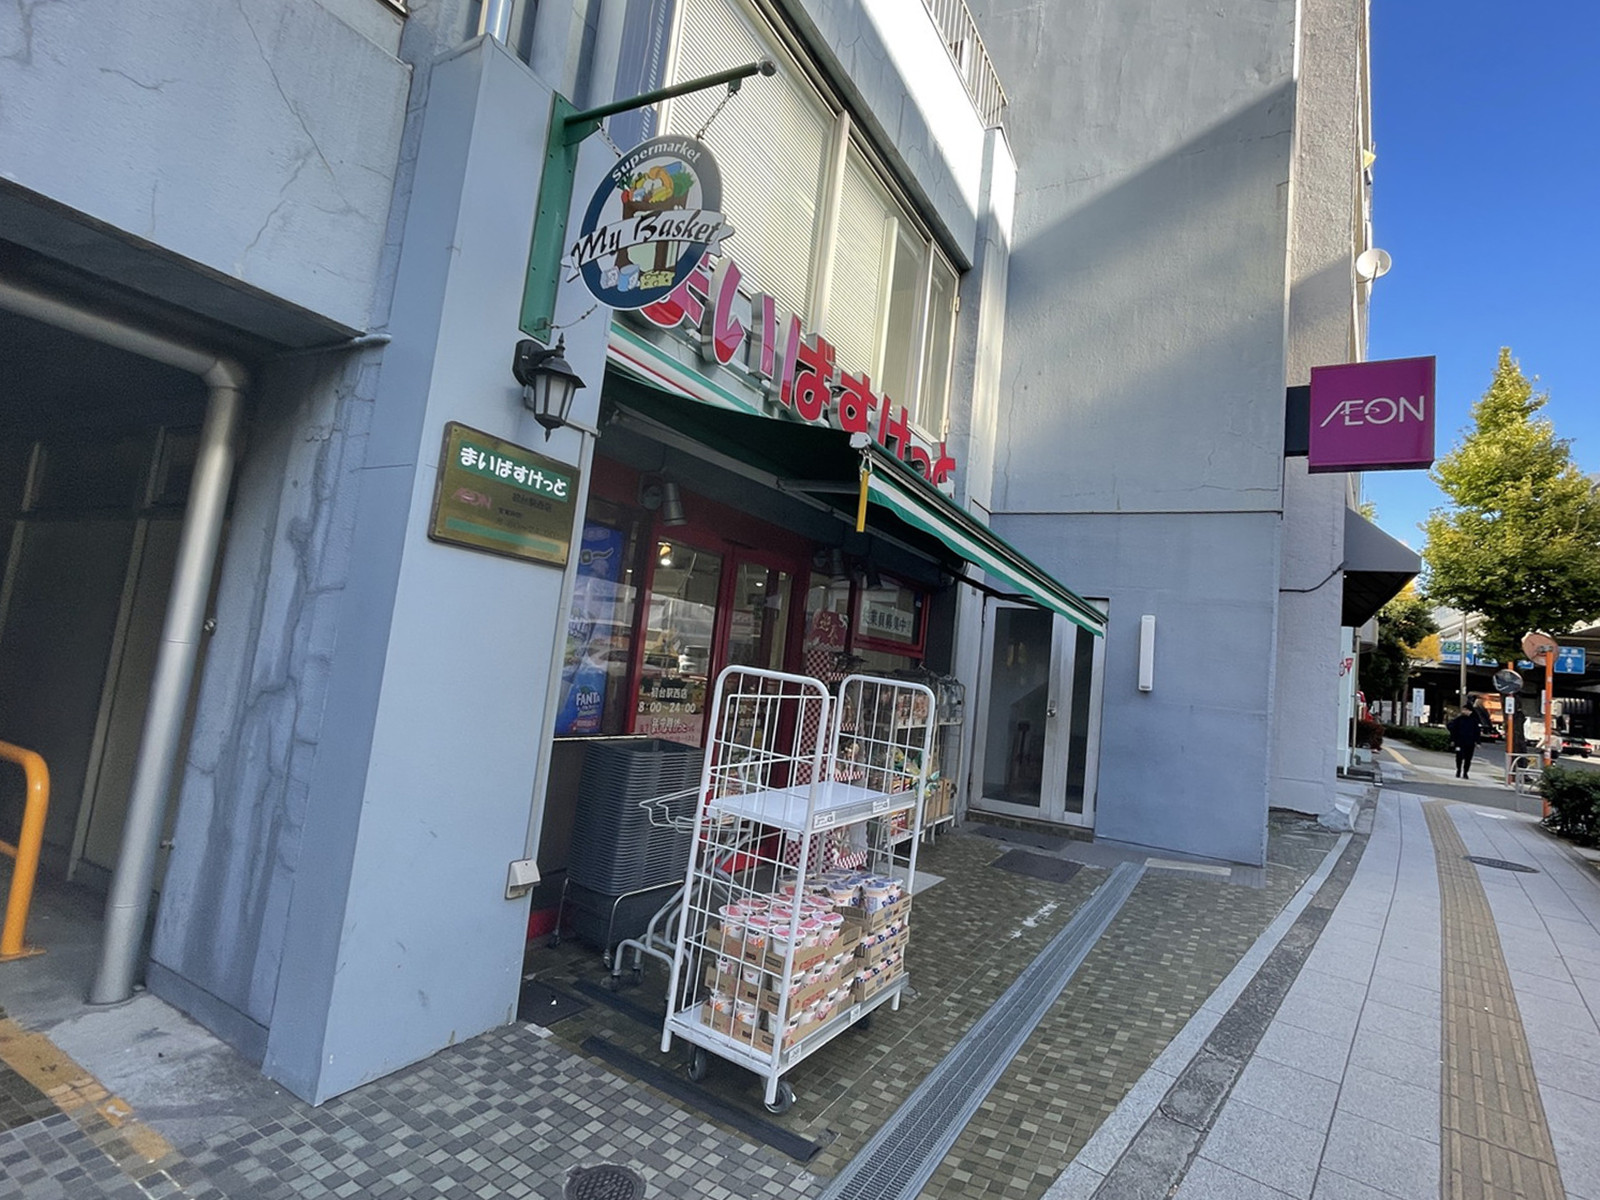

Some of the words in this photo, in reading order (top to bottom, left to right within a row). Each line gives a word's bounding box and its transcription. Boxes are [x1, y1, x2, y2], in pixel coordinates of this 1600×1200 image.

[612, 141, 702, 183] supermarket
[571, 225, 622, 265] My
[633, 209, 721, 245] Basket
[460, 446, 567, 497] まいばすけっと
